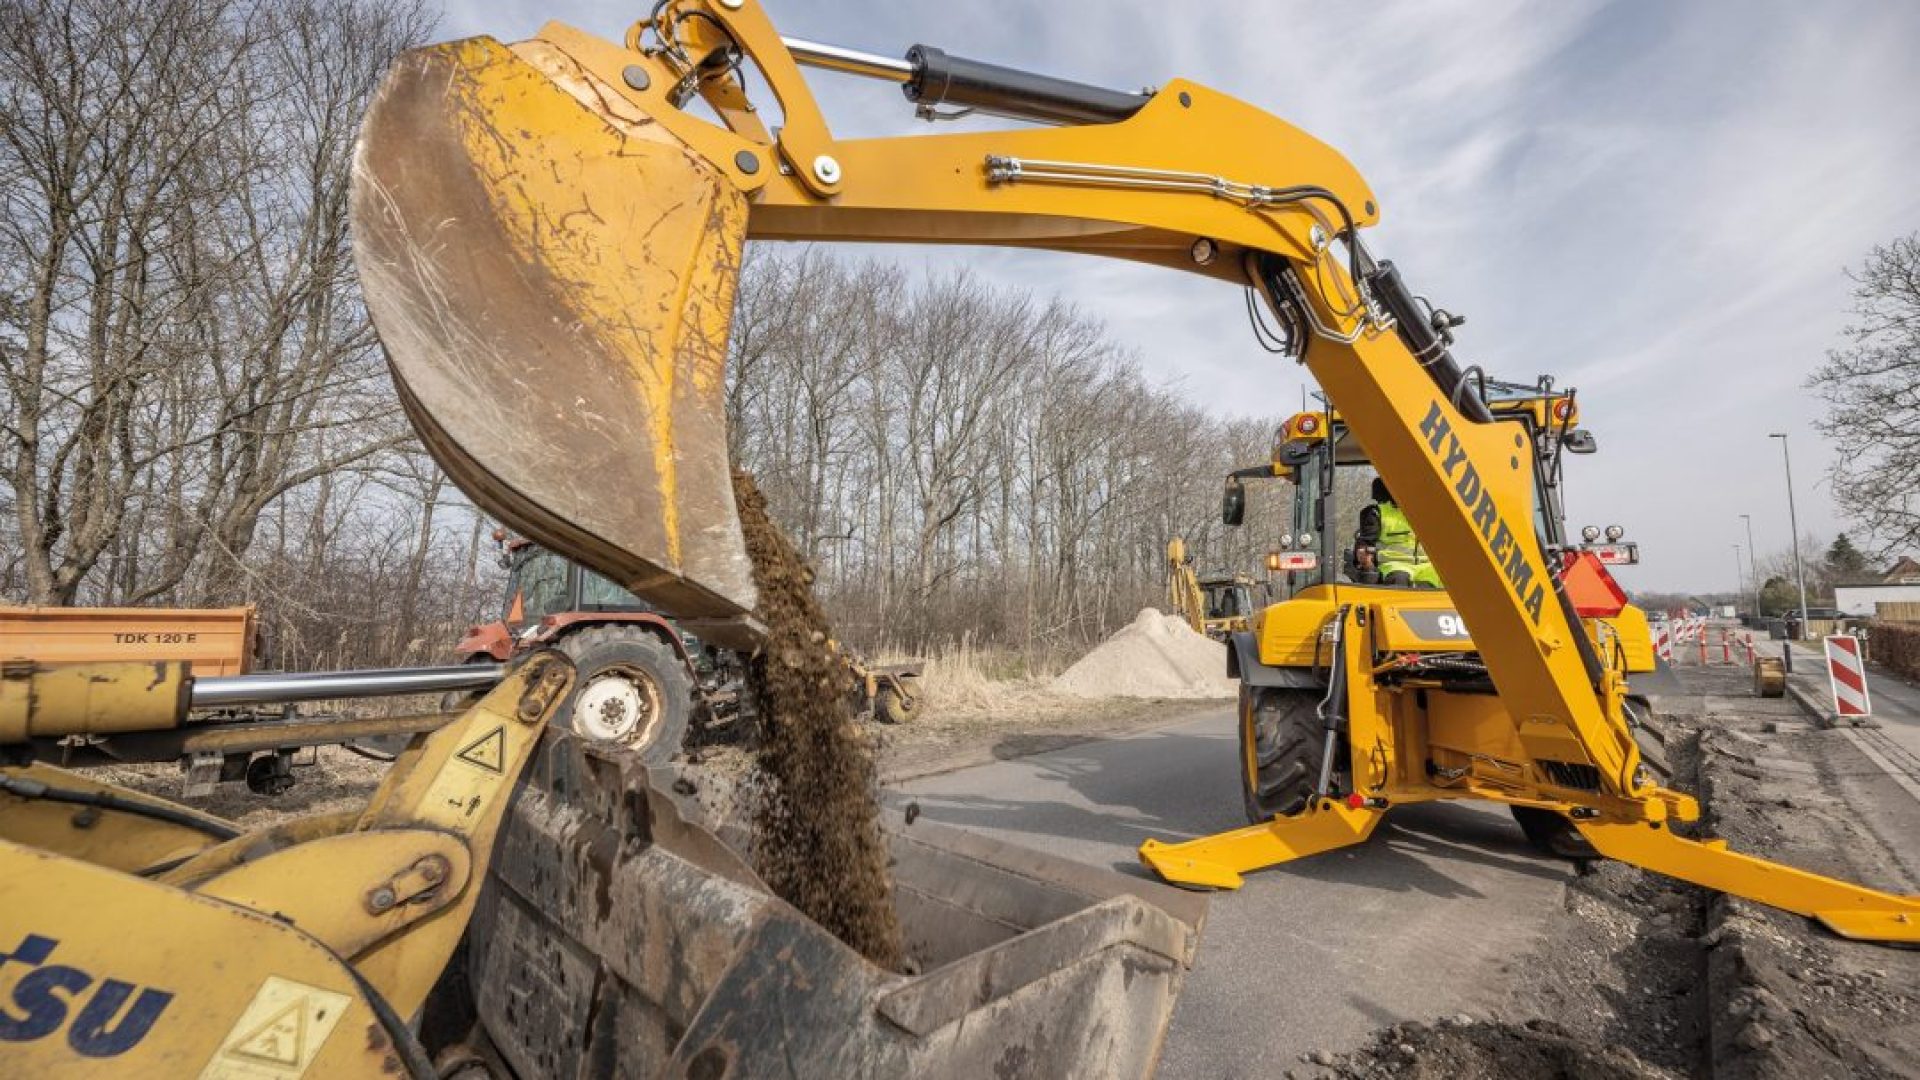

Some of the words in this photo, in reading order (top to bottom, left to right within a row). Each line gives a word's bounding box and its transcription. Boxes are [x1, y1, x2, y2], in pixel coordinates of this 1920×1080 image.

[1420, 399, 1544, 626] HYDREMA
[113, 633, 148, 643] TDK
[155, 633, 181, 643] 120
